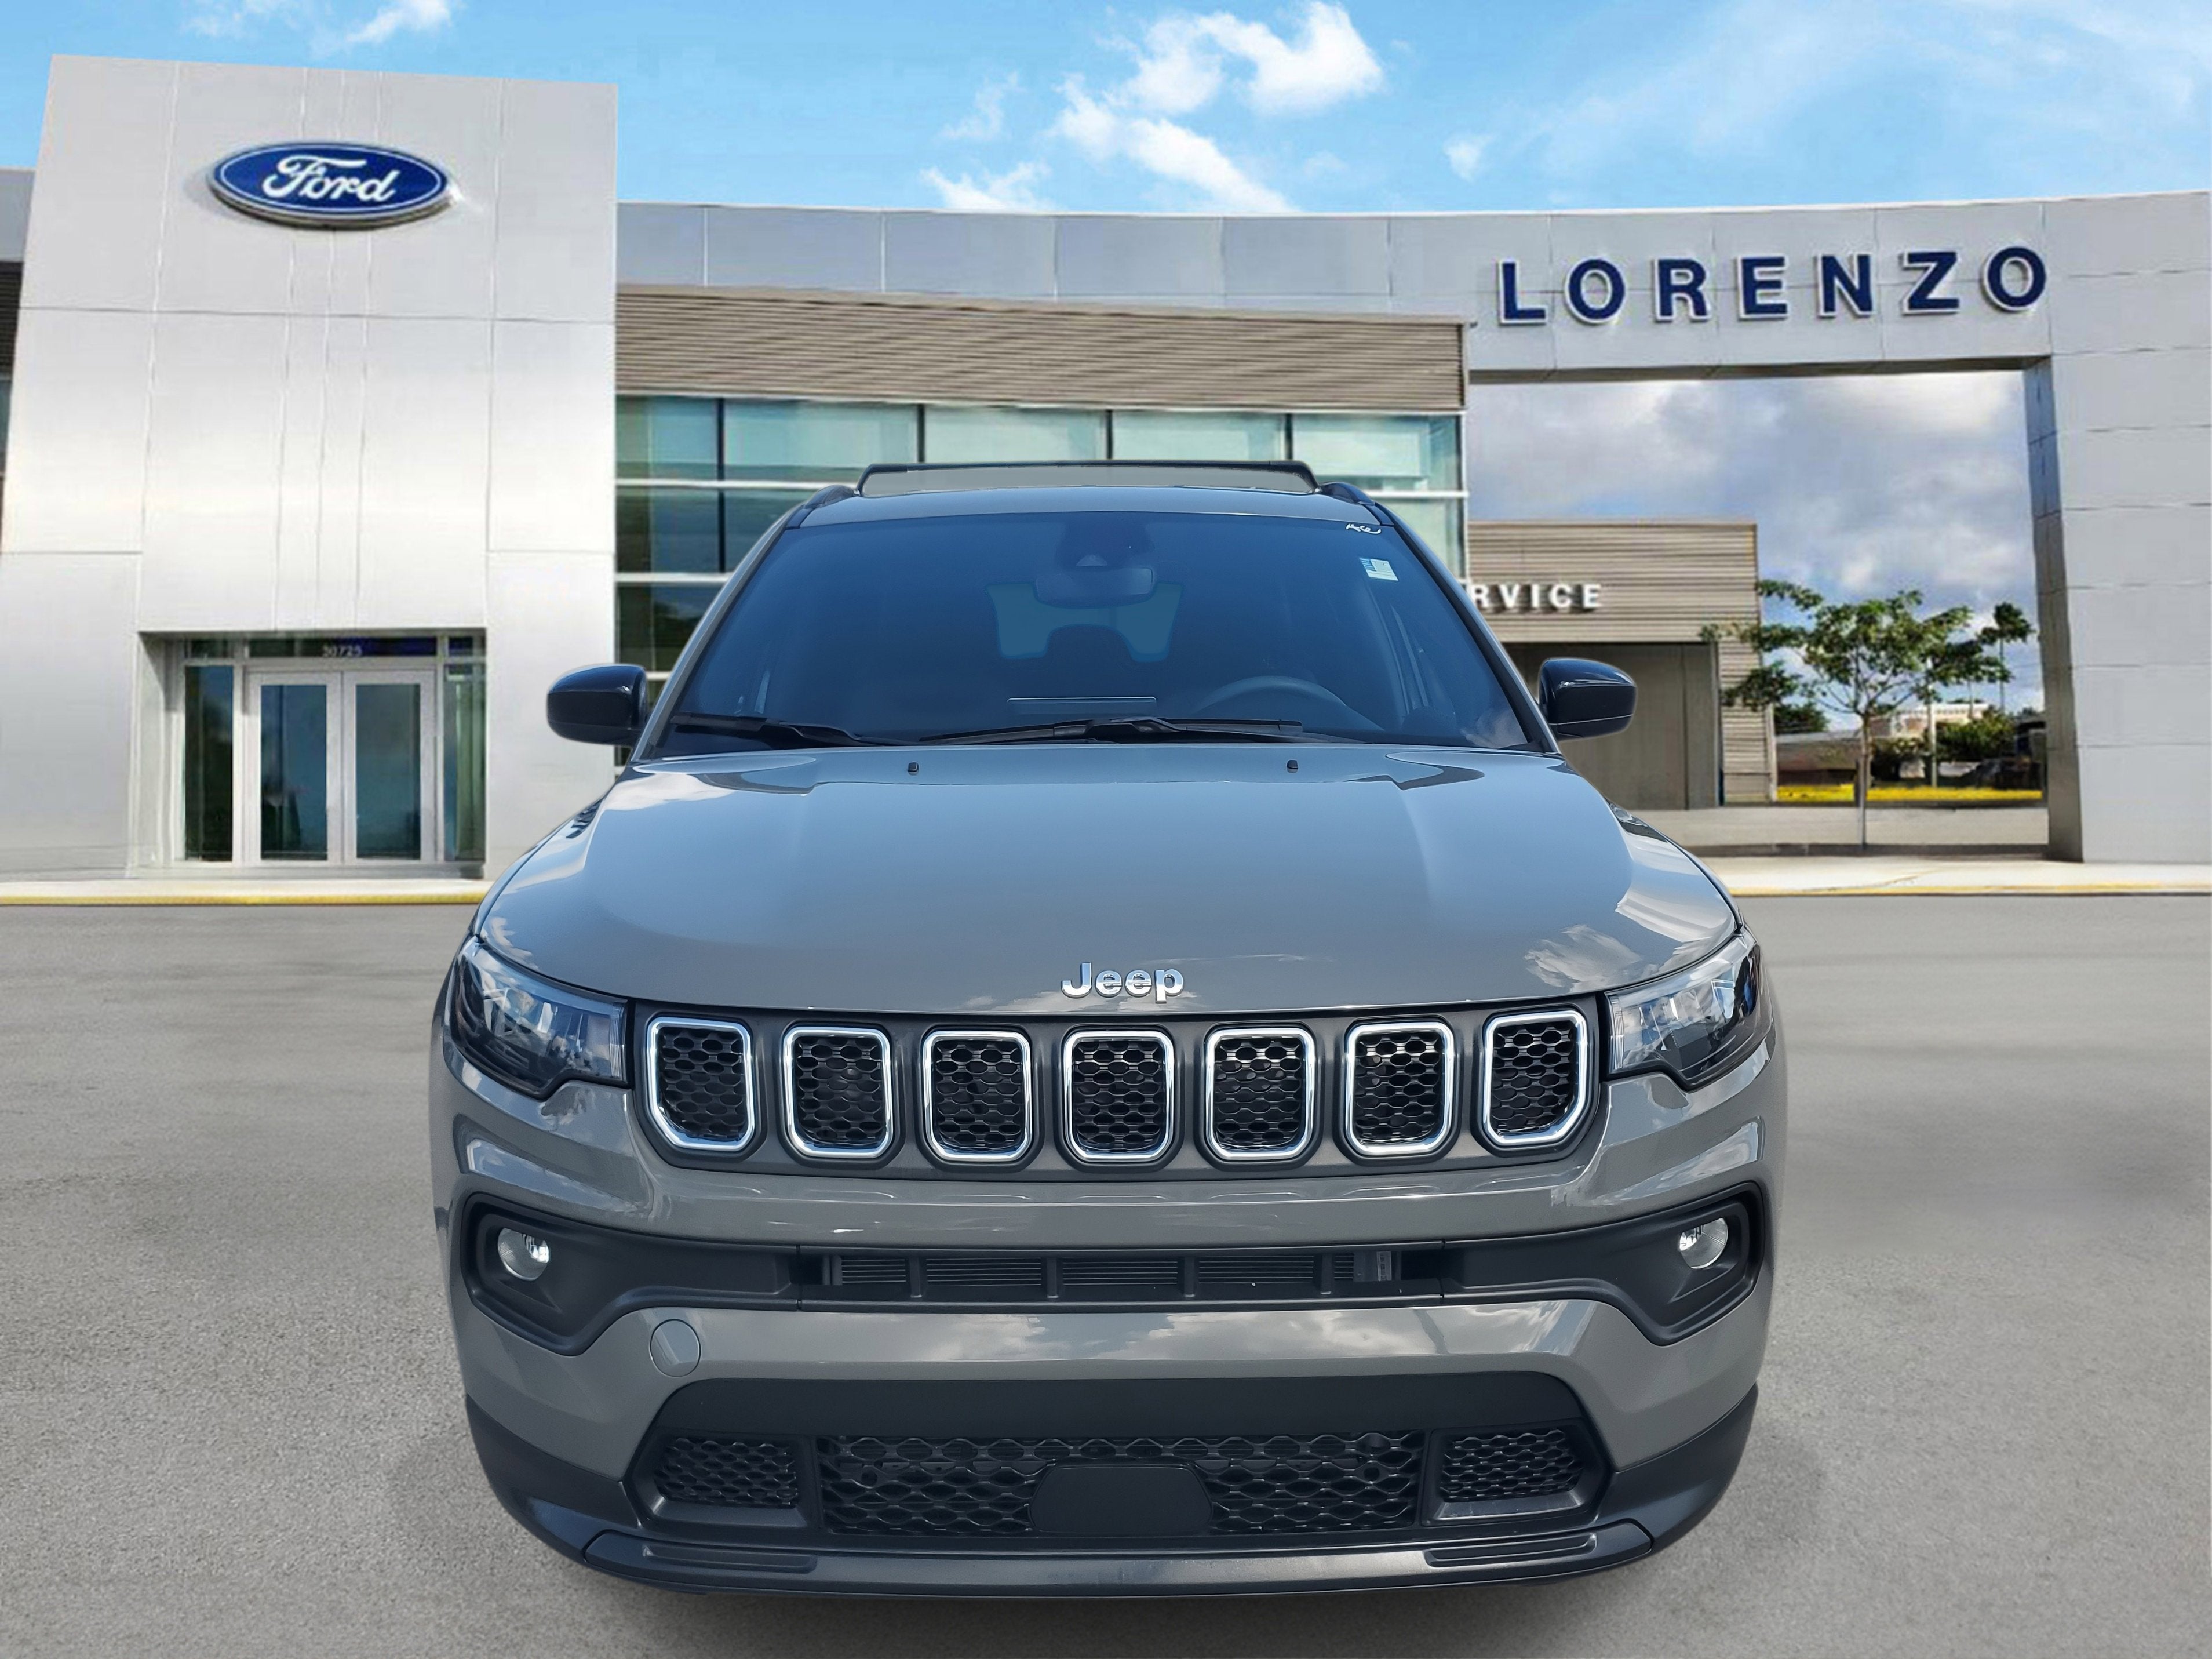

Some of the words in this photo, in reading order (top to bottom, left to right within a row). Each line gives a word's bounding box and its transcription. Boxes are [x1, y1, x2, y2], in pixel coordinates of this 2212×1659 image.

[263, 155, 400, 201] Ford
[1499, 246, 2047, 326] LORENZO
[1061, 962, 1184, 1003] Jeep
